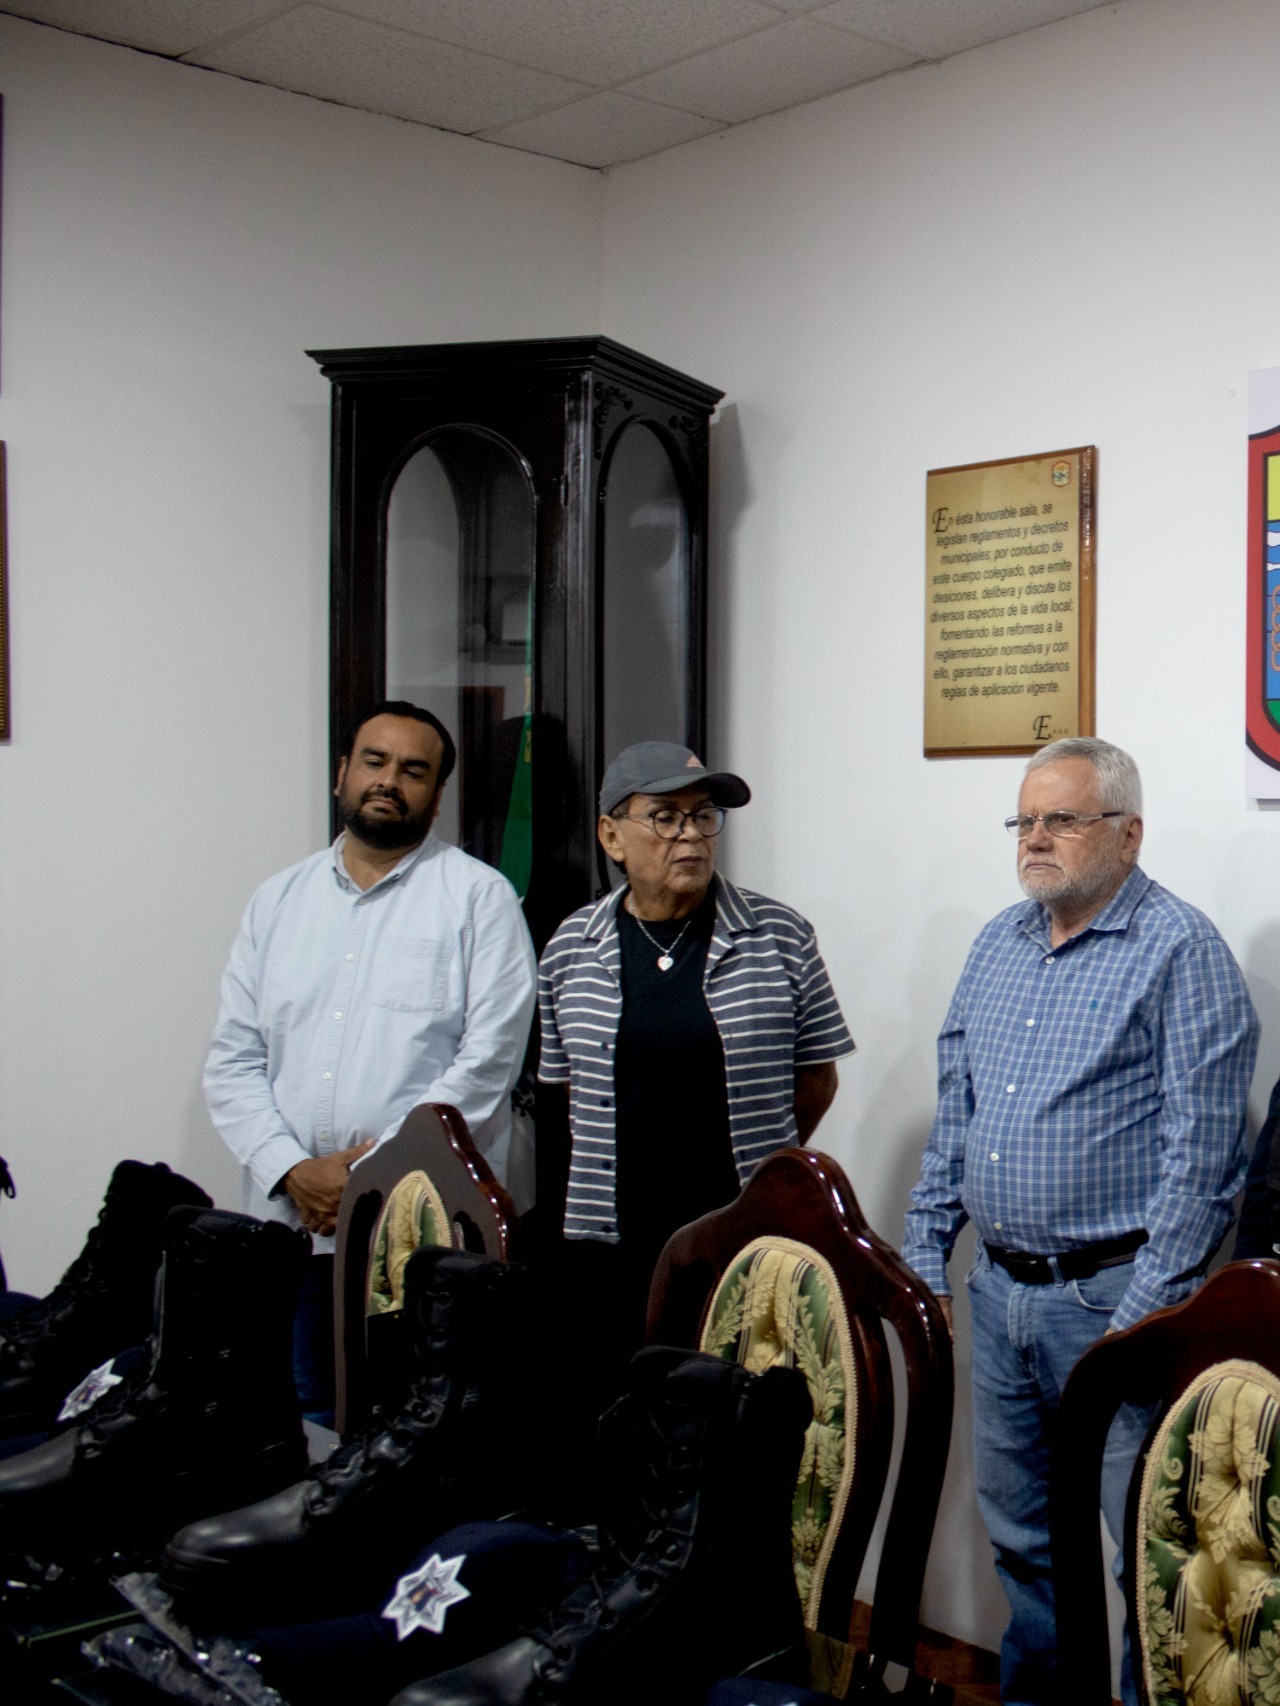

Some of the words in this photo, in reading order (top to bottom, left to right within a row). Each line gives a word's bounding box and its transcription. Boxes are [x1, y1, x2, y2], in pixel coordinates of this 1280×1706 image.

[975, 505, 1017, 522] honorable
[1042, 503, 1053, 514] se
[936, 532, 968, 549] legislan
[970, 526, 1021, 545] reglamentos
[1023, 527, 1029, 539] y
[1030, 520, 1068, 535] decretos
[994, 549, 1008, 561] por
[1011, 542, 1049, 557] conducto
[1052, 540, 1063, 552] de
[933, 571, 951, 585] este
[952, 570, 981, 584] cuerpo
[1029, 563, 1045, 577] que
[1047, 559, 1072, 573] emite
[981, 585, 1015, 599] delibera
[1017, 587, 1022, 599] y
[1025, 582, 1056, 594] discute
[1058, 580, 1071, 591] los
[930, 609, 965, 623] diversos
[967, 605, 1005, 622] aspectos
[1007, 604, 1018, 616] de
[1020, 603, 1028, 615] la
[1031, 601, 1048, 614] vida
[940, 628, 989, 641] fomentando
[991, 625, 1004, 637] las
[1006, 622, 1044, 635] reformas
[1047, 623, 1052, 632] a
[1055, 620, 1063, 632] la
[934, 646, 998, 662] reglamentación
[1000, 641, 1043, 656] normativa
[1045, 643, 1051, 656] y
[1053, 641, 1069, 652] con
[952, 664, 995, 681] garantizar
[997, 666, 1002, 676] a
[1005, 663, 1017, 676] los
[1020, 661, 1070, 674] ciudadanos
[941, 686, 967, 700] reglas
[968, 684, 979, 696] de
[981, 681, 1025, 698] aplicación
